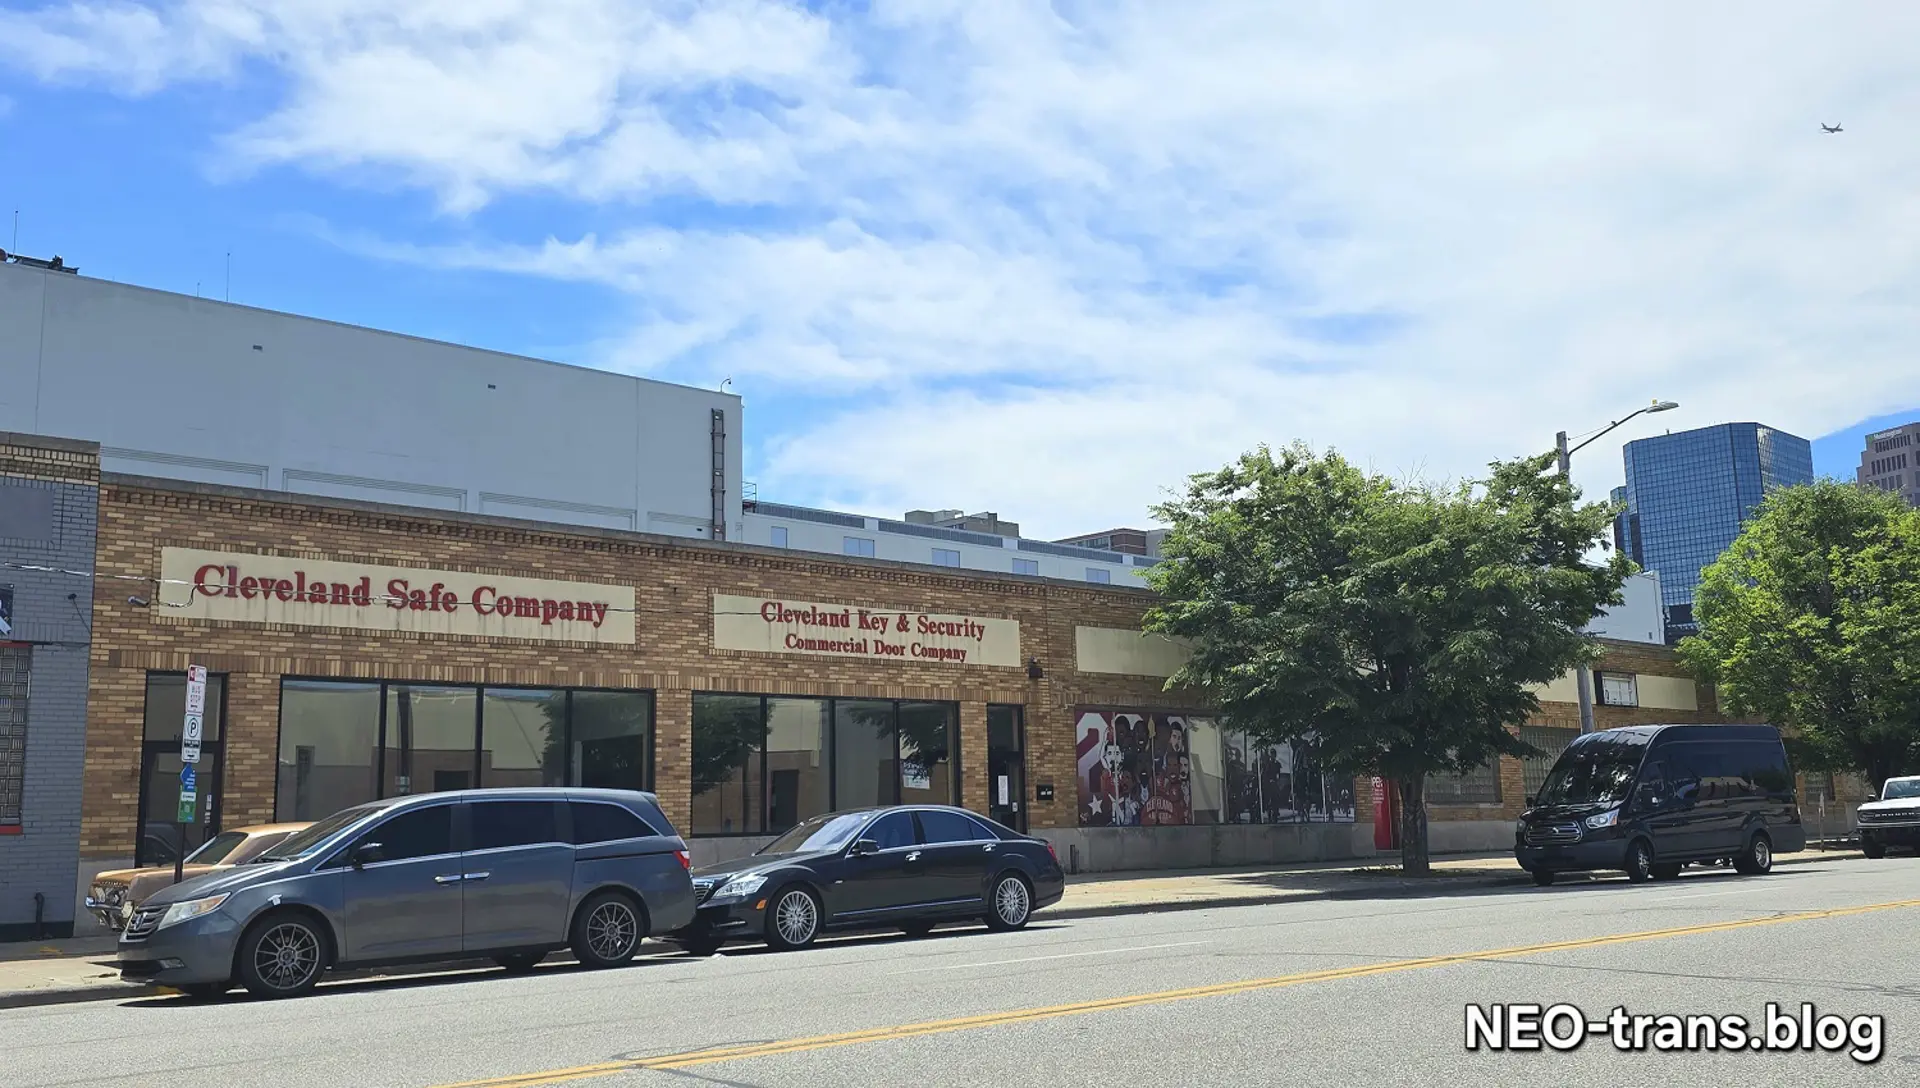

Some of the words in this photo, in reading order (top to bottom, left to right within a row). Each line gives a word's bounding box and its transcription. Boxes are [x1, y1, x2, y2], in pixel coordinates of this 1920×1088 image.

[194, 564, 371, 607] Cleveland
[387, 578, 458, 613] Safe
[472, 586, 609, 628] Company
[760, 601, 850, 628] Cleveland
[858, 609, 889, 635] Key
[896, 612, 910, 633] &
[917, 615, 986, 641] Security
[785, 633, 868, 654] Commercial
[873, 639, 906, 657] Door
[911, 642, 967, 662] Company
